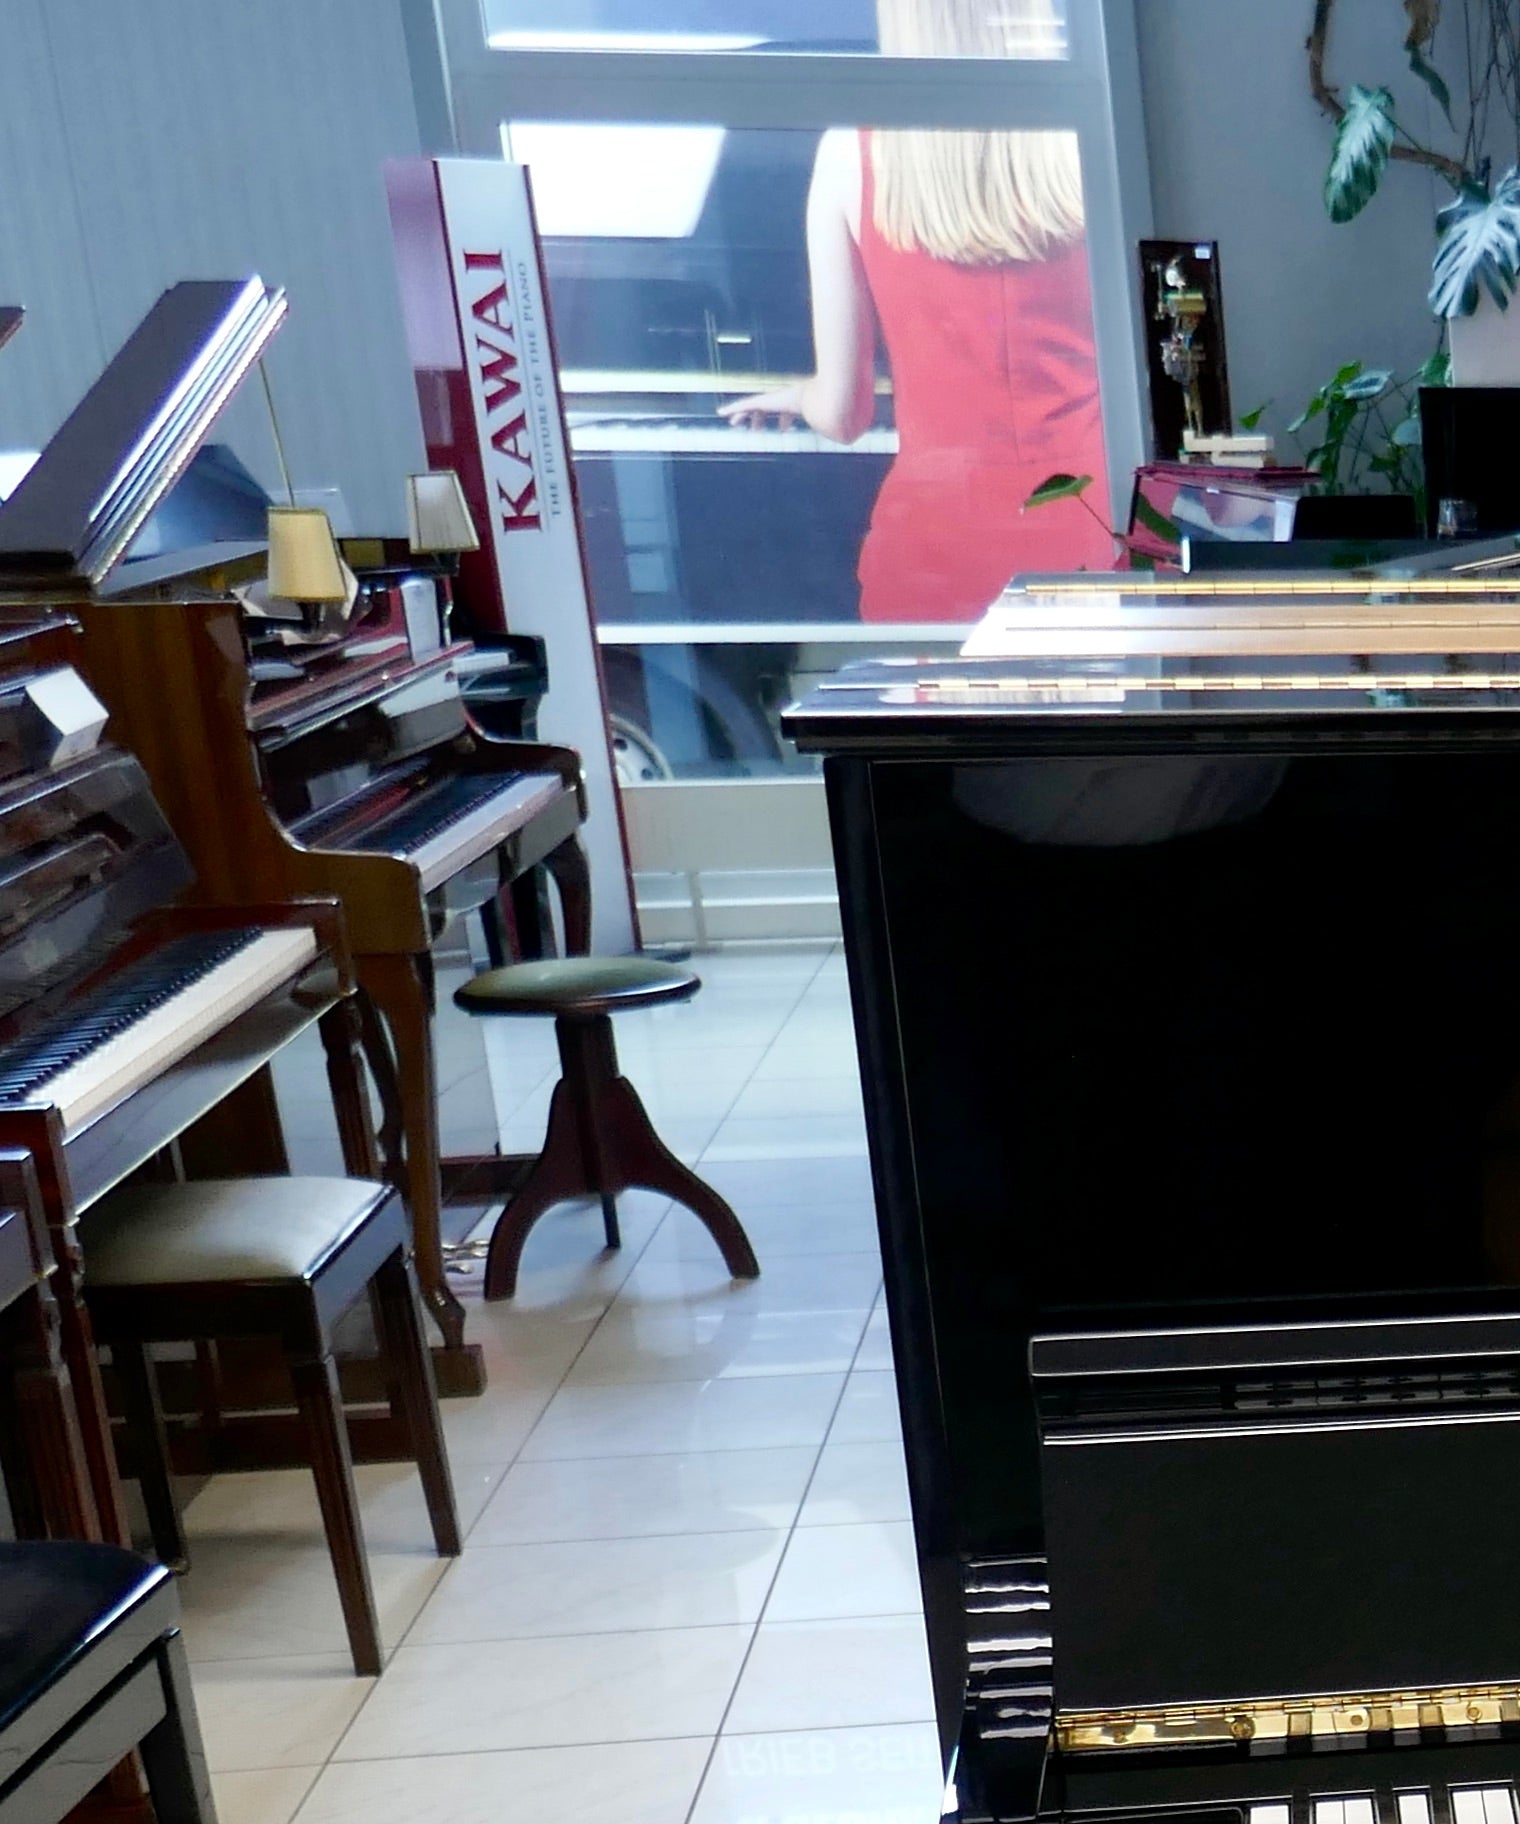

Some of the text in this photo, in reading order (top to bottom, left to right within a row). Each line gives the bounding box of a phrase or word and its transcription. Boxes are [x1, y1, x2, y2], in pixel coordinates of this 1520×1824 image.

[517, 261, 535, 322] PIANO
[528, 329, 542, 364] THE
[463, 249, 542, 535] KAWAI
[539, 404, 556, 475] FUTURE
[548, 481, 562, 517] THE
